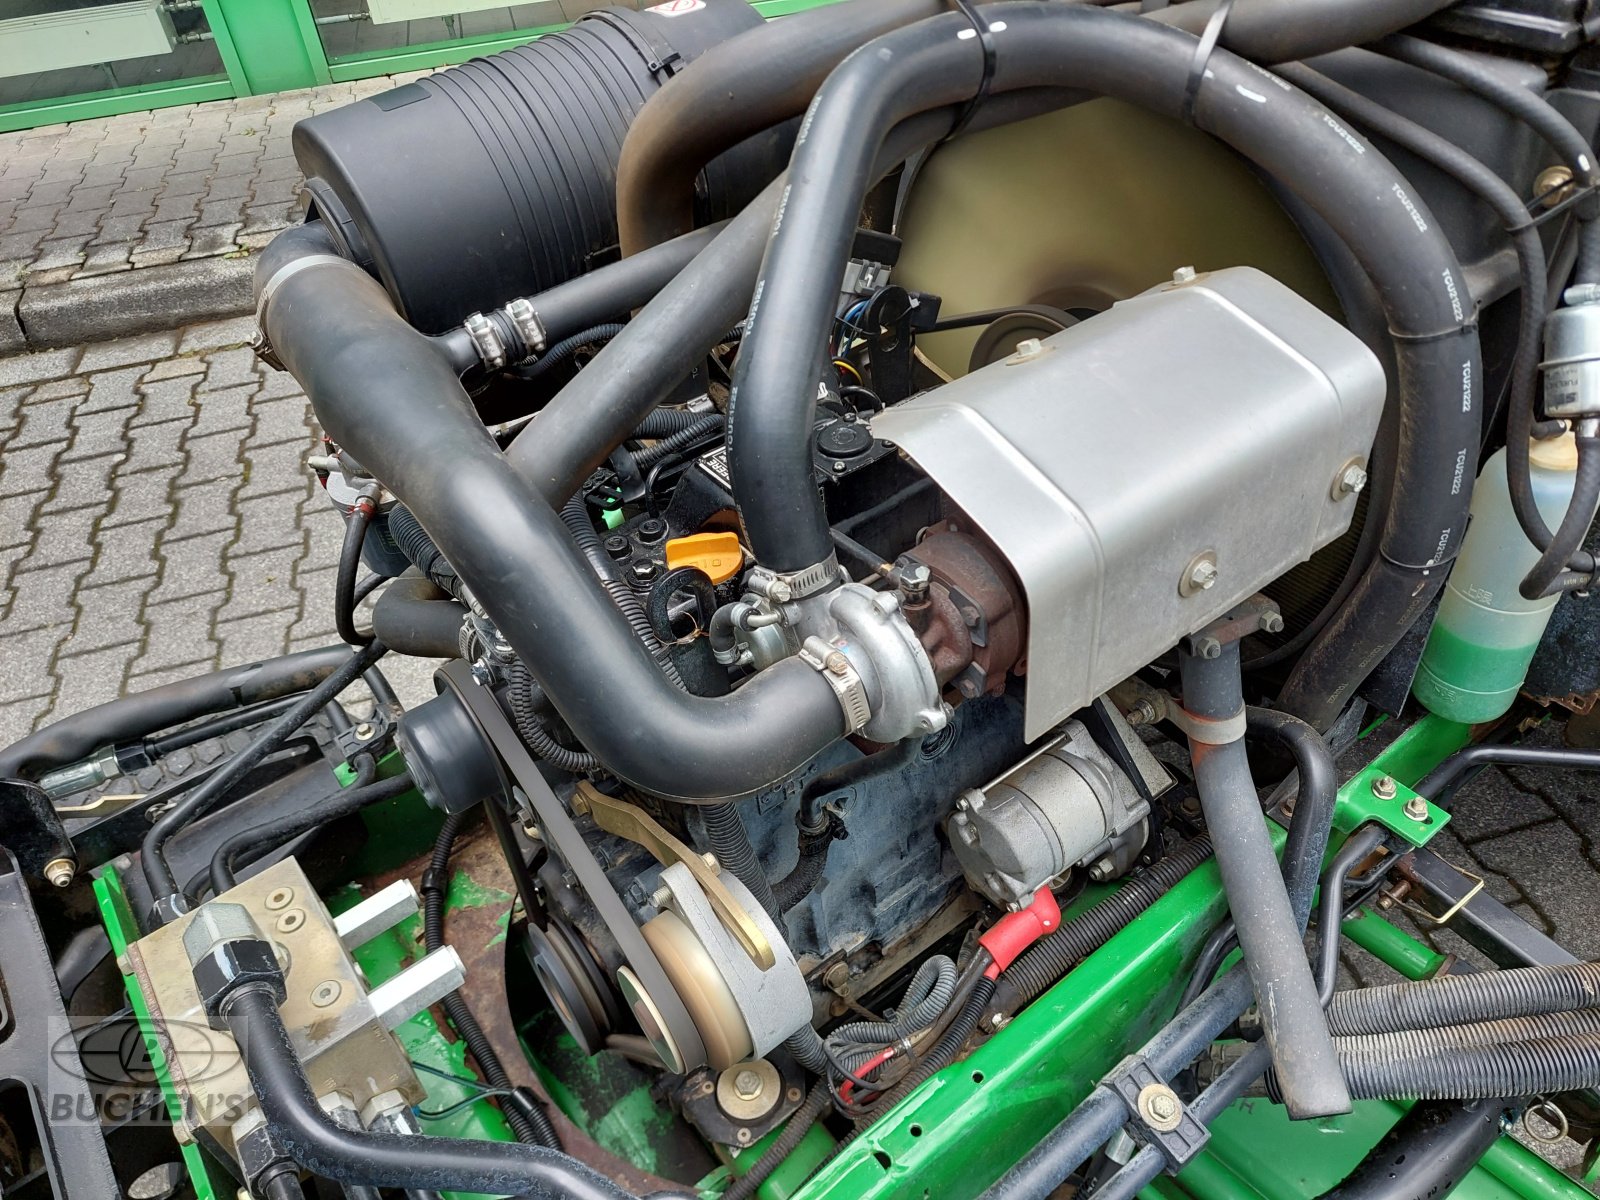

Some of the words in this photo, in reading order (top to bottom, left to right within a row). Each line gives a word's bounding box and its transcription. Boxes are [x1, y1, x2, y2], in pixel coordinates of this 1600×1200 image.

[1323, 114, 1366, 154] TCU21222
[1391, 182, 1428, 233] TCU21222
[745, 280, 766, 337] TCU21222
[1442, 267, 1464, 322] TCU21222
[1462, 360, 1472, 412] TCU21222
[728, 387, 738, 452] TCU21222
[1451, 448, 1467, 495] TCU21222
